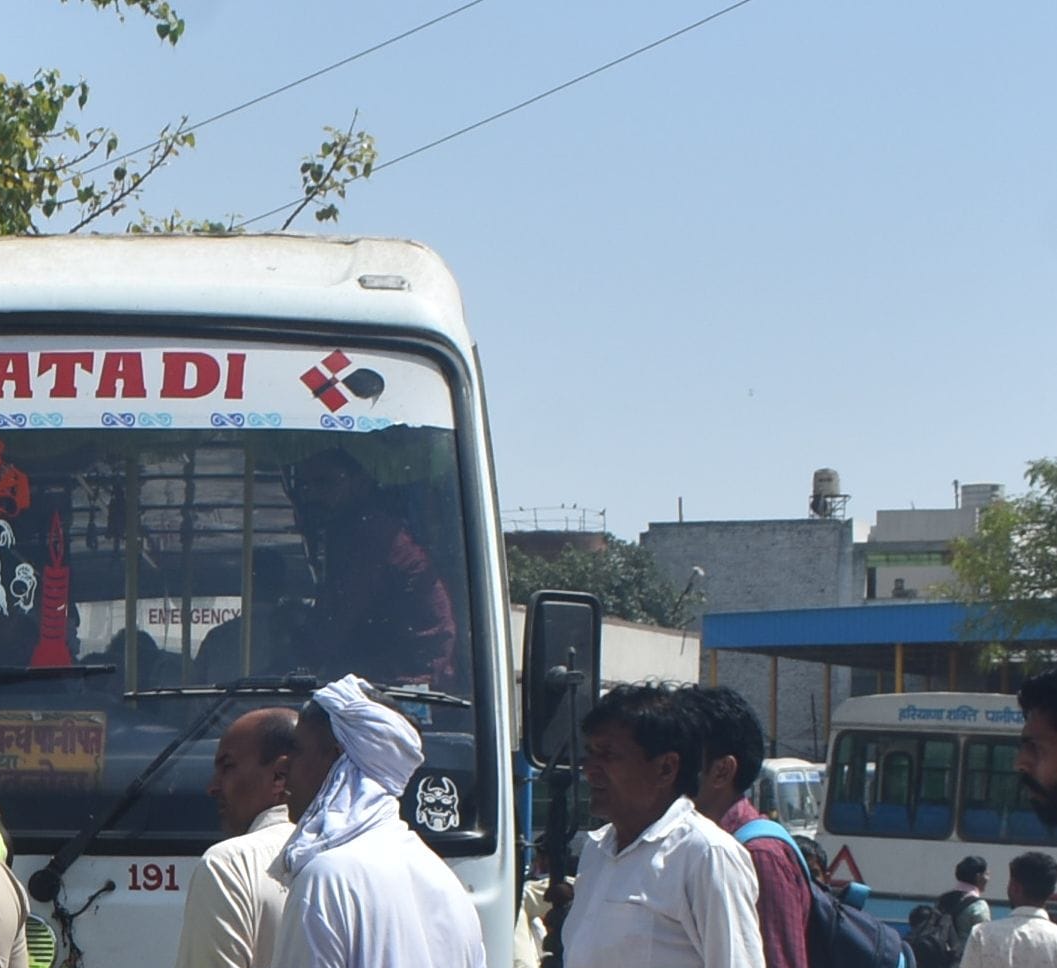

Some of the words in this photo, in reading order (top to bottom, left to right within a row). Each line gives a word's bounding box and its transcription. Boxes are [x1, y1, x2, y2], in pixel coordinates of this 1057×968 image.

[160, 352, 247, 400] DI
[898, 704, 945, 721] हरियाणा
[985, 706, 1025, 725] पानीप
[128, 863, 180, 892] 191
